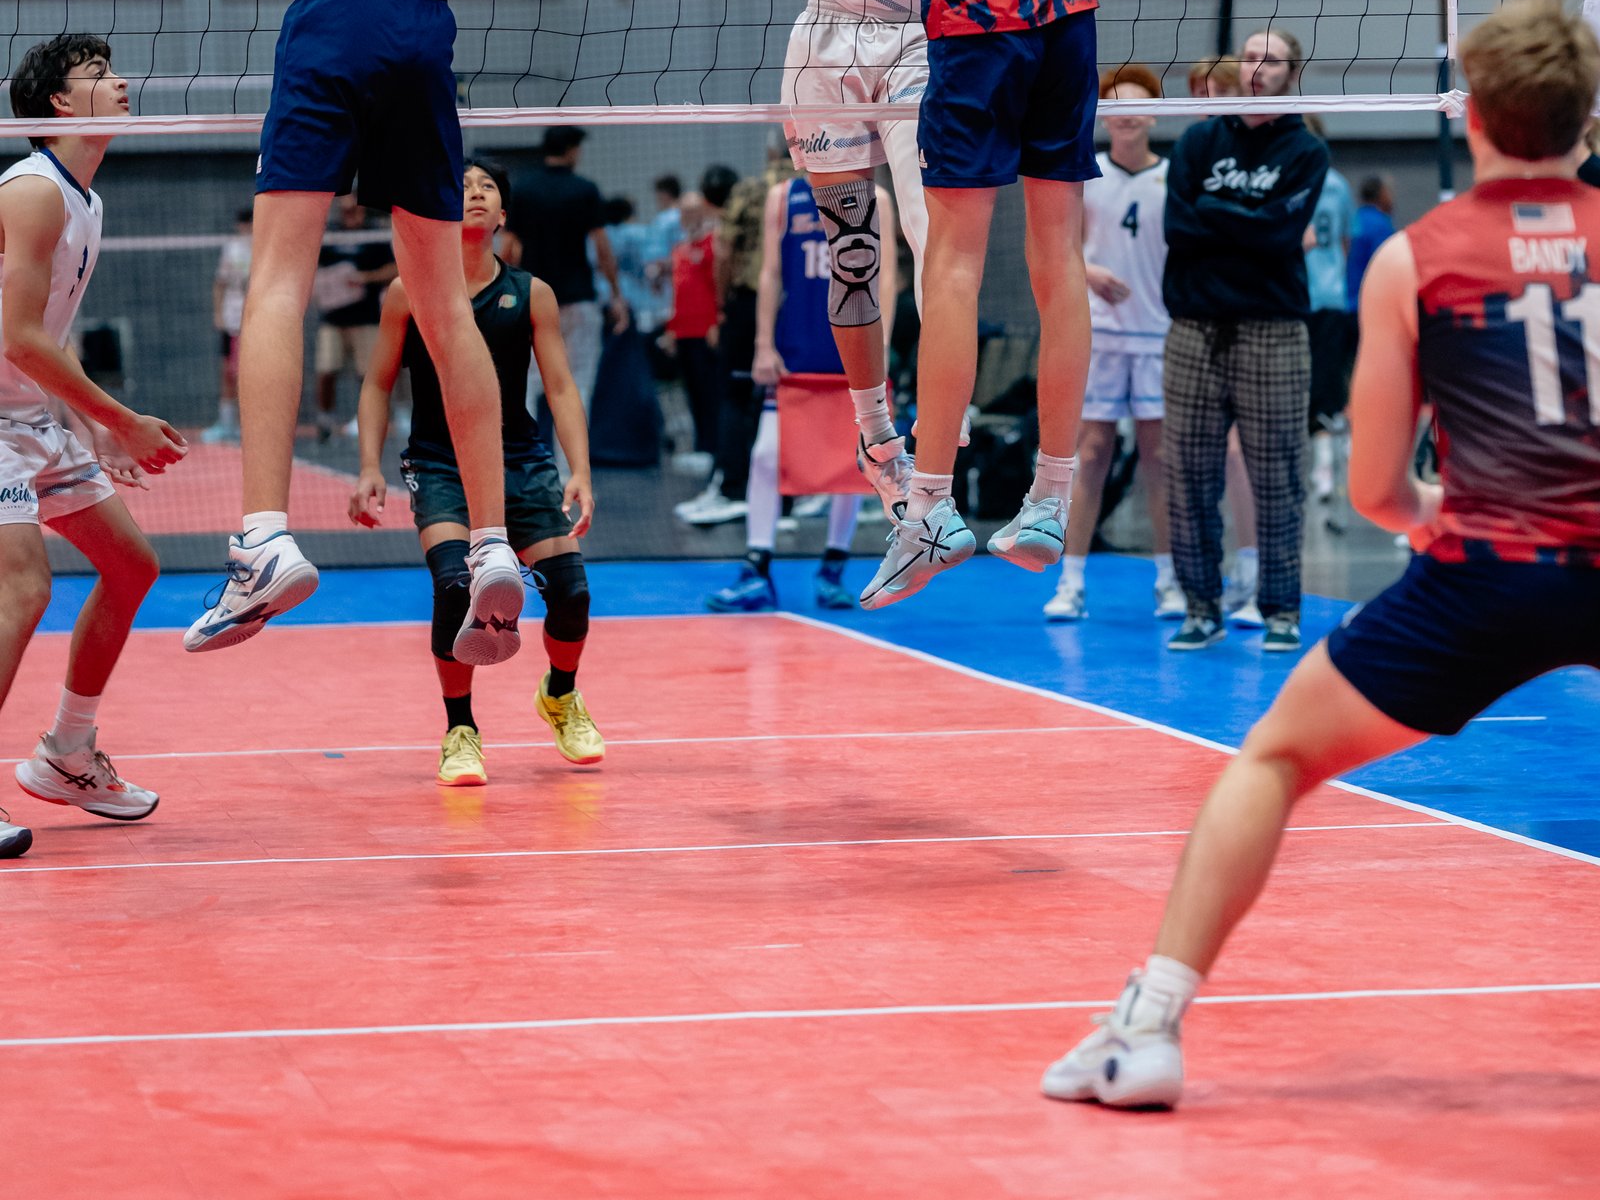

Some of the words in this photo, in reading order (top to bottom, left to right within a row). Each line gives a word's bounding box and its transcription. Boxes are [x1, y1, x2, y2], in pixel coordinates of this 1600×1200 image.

[1120, 201, 1139, 238] 4
[1508, 236, 1587, 274] BANDY
[1505, 283, 1600, 426] 11
